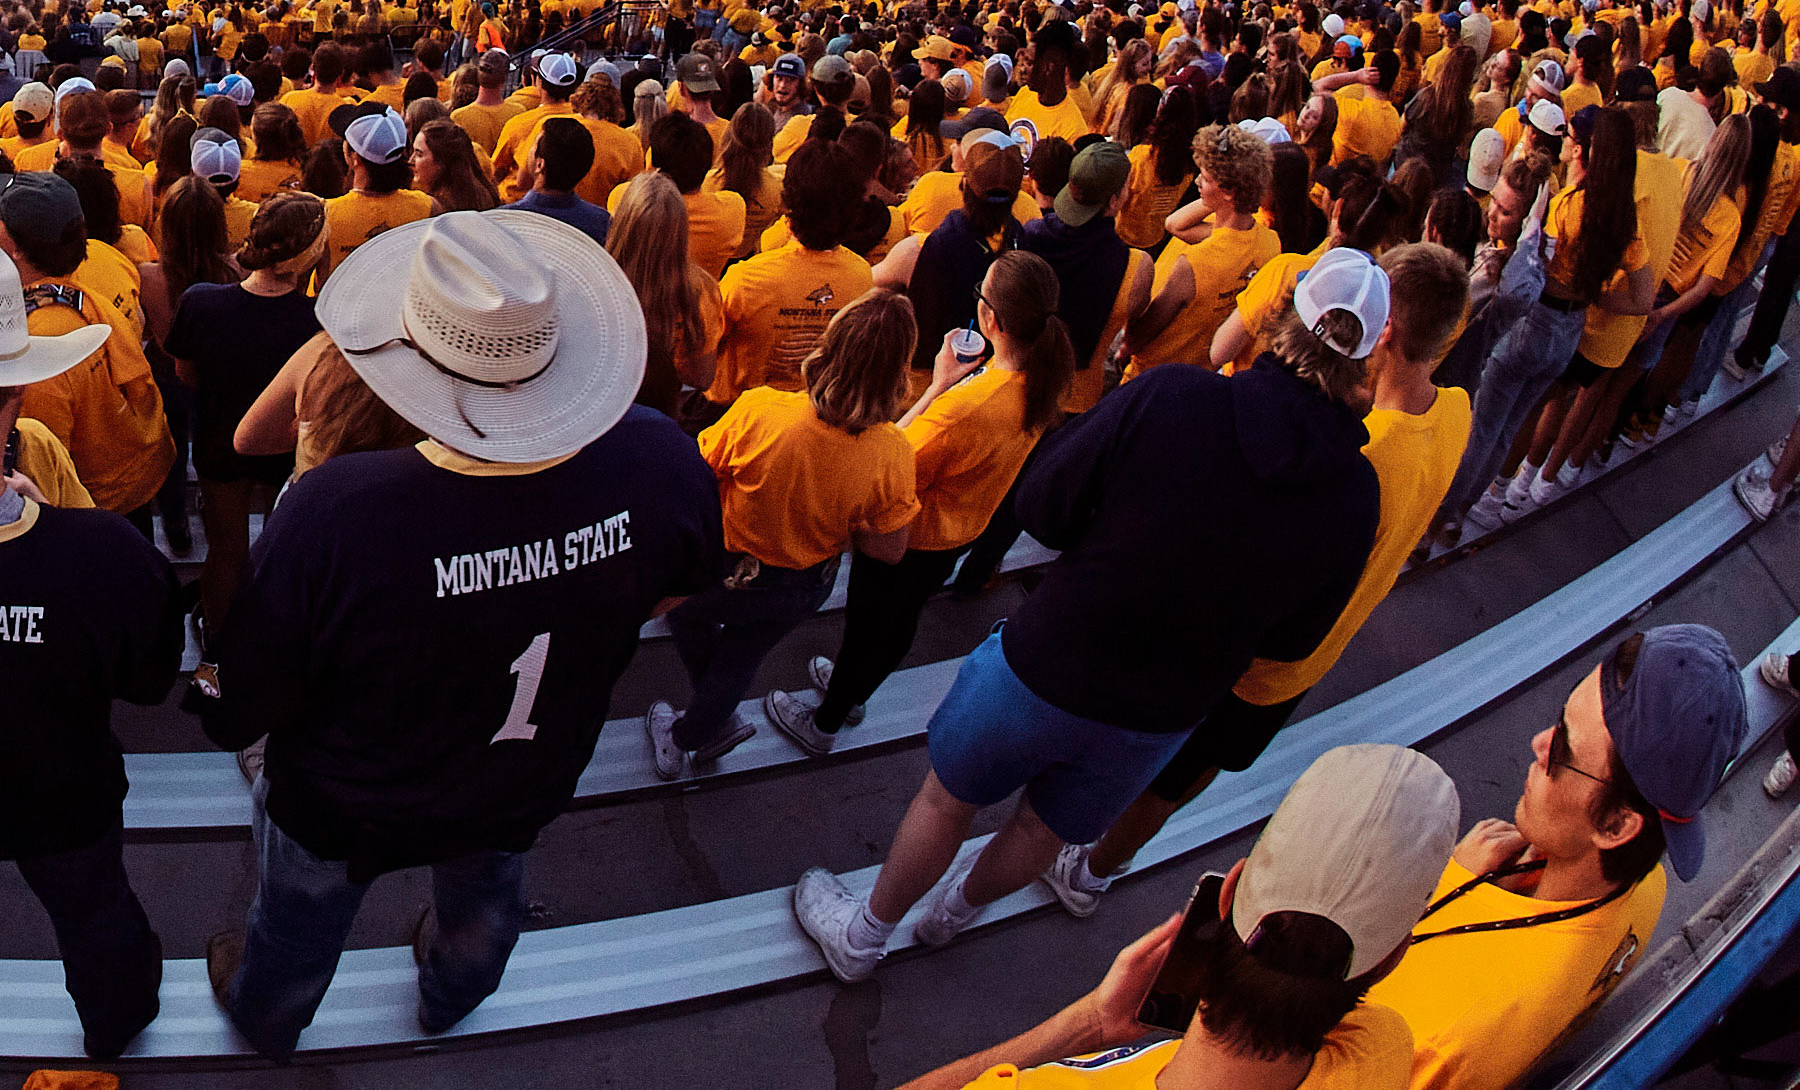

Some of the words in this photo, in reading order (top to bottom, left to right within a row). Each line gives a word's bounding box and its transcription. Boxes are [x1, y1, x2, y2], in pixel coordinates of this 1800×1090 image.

[434, 538, 559, 598] MONTANA
[564, 510, 633, 571] STATE
[489, 632, 550, 746] 1
